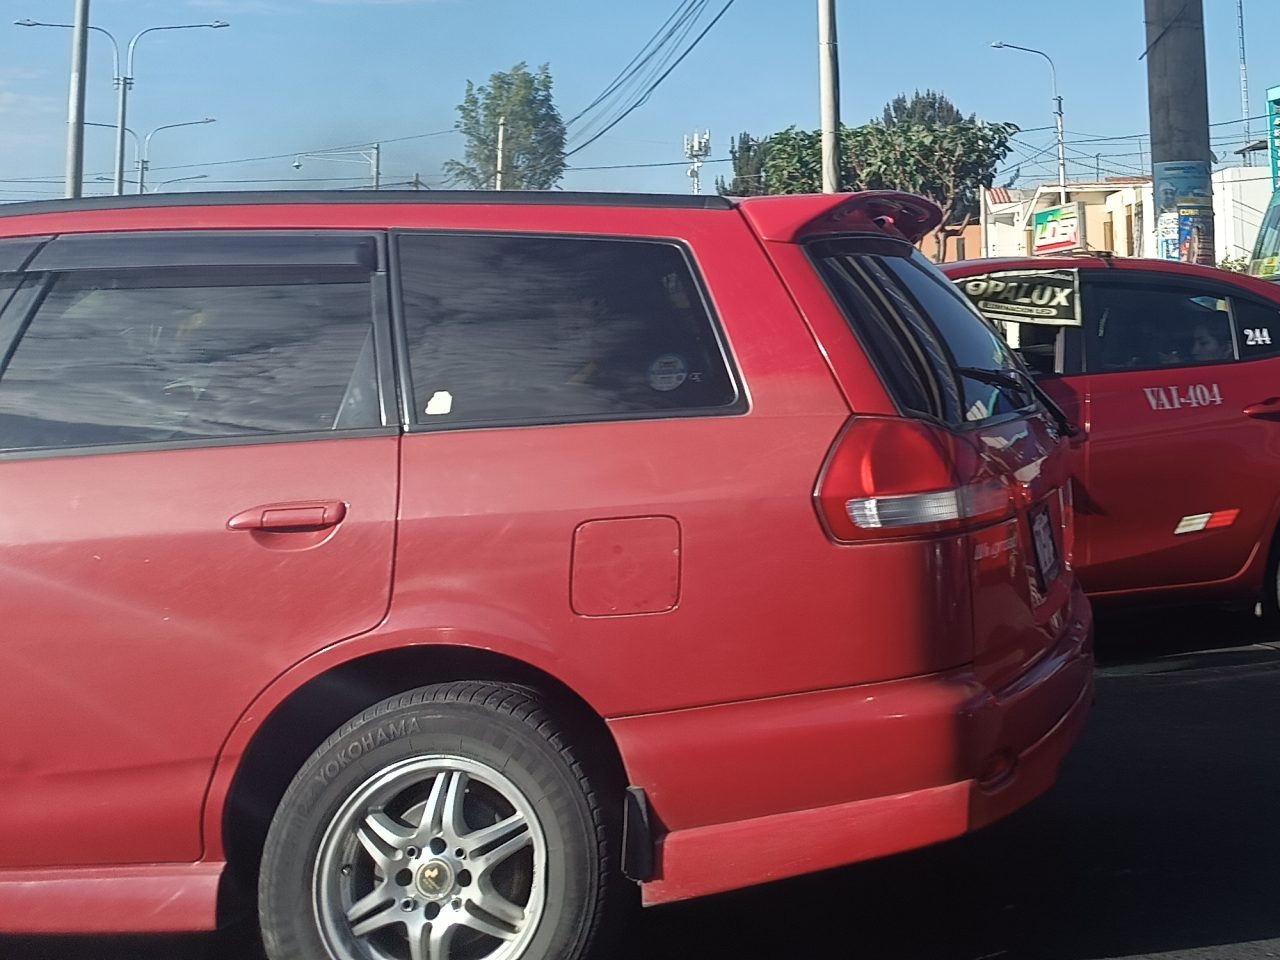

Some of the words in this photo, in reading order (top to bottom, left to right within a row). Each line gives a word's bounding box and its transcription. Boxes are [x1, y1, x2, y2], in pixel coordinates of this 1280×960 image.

[966, 281, 1073, 306] OPALUX
[1243, 328, 1272, 345] 244
[1143, 383, 1224, 410] VAI-404
[315, 717, 421, 785] YOKOHAMA
